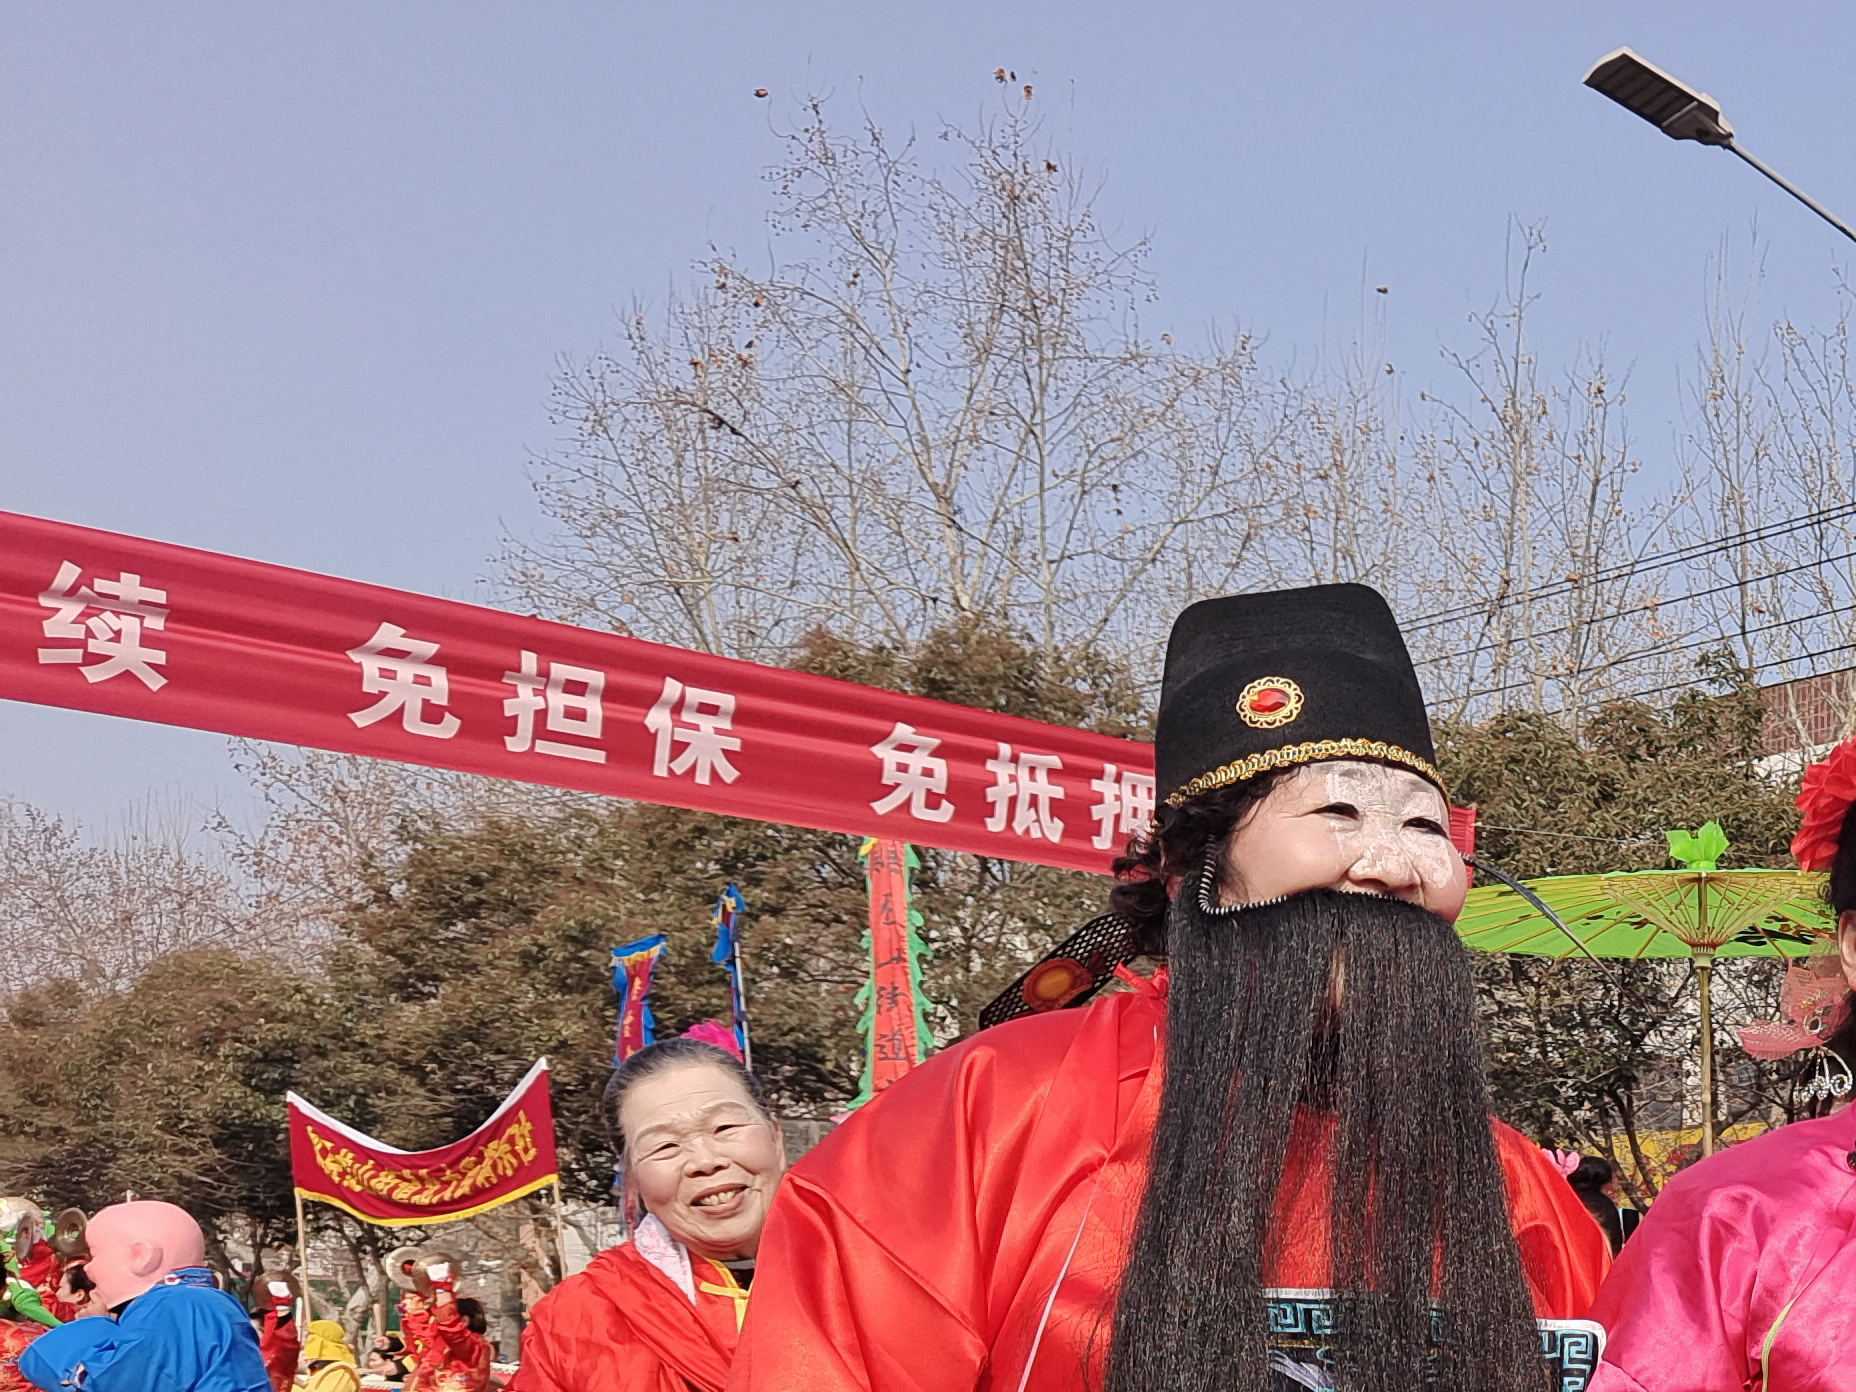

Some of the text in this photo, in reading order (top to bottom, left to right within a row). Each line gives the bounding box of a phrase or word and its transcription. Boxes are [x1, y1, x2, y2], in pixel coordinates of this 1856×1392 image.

[38, 560, 1156, 851] 续 免担保 免抵押
